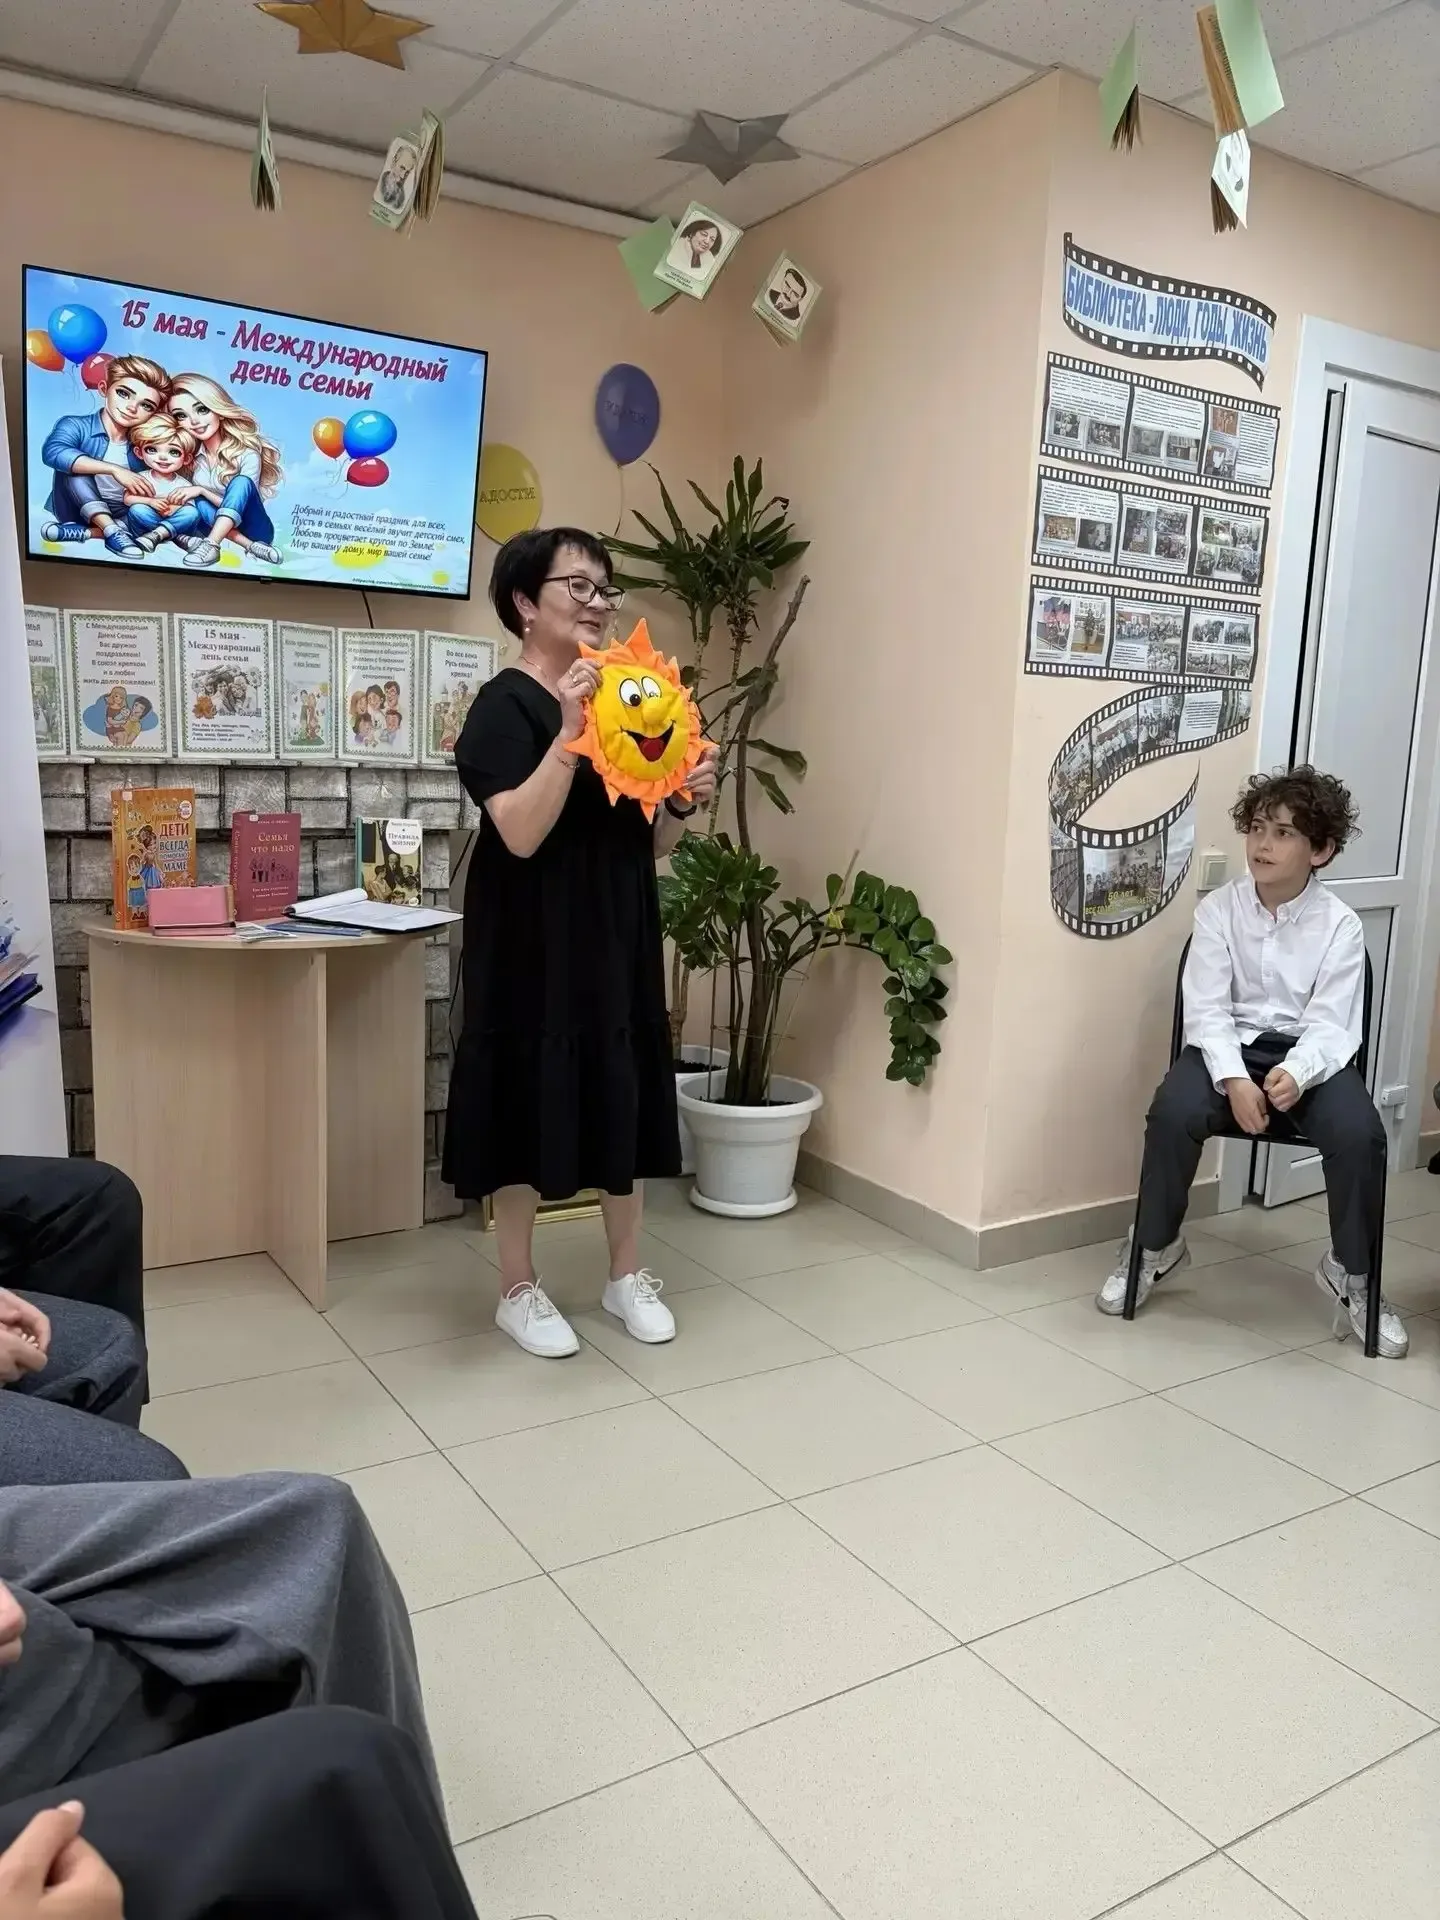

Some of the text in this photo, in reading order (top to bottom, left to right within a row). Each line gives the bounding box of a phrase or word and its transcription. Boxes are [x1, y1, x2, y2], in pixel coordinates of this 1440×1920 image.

[1067, 265, 1147, 332] БИБЛИОТЕКА
[1153, 296, 1190, 346] ЛЮДИ,
[1194, 301, 1227, 348] ГОДЫ,
[1230, 310, 1267, 363] ЖИЗНЬ
[122, 300, 149, 328] 15
[153, 312, 208, 340] мая
[231, 320, 449, 382] Международный
[230, 360, 374, 400] день семьи
[480, 487, 536, 504] АДОСТИ
[291, 504, 324, 517] Добрый
[325, 509, 331, 517] и
[332, 511, 374, 521] радостный
[376, 515, 410, 526] праздник
[412, 519, 426, 528] для
[292, 515, 315, 526] Пусть
[325, 521, 352, 530] семьях
[387, 528, 413, 538] звучит
[414, 531, 445, 541] детский
[291, 526, 322, 538] Любовь
[324, 532, 367, 543] процветает
[369, 536, 396, 547] кругом
[398, 540, 408, 548] по
[291, 539, 309, 550] Мир
[311, 543, 342, 554] вашему
[343, 545, 365, 556] дому,
[367, 548, 382, 558] мир
[384, 549, 407, 559] вашей
[204, 629, 217, 639] 15
[219, 632, 240, 641] мая
[188, 641, 261, 654] Международный
[200, 654, 250, 663] день семьи
[160, 823, 189, 837] ДЕТИ
[258, 832, 288, 842] Семья
[160, 840, 188, 851] ВСЕГДА
[250, 844, 295, 854] что надо
